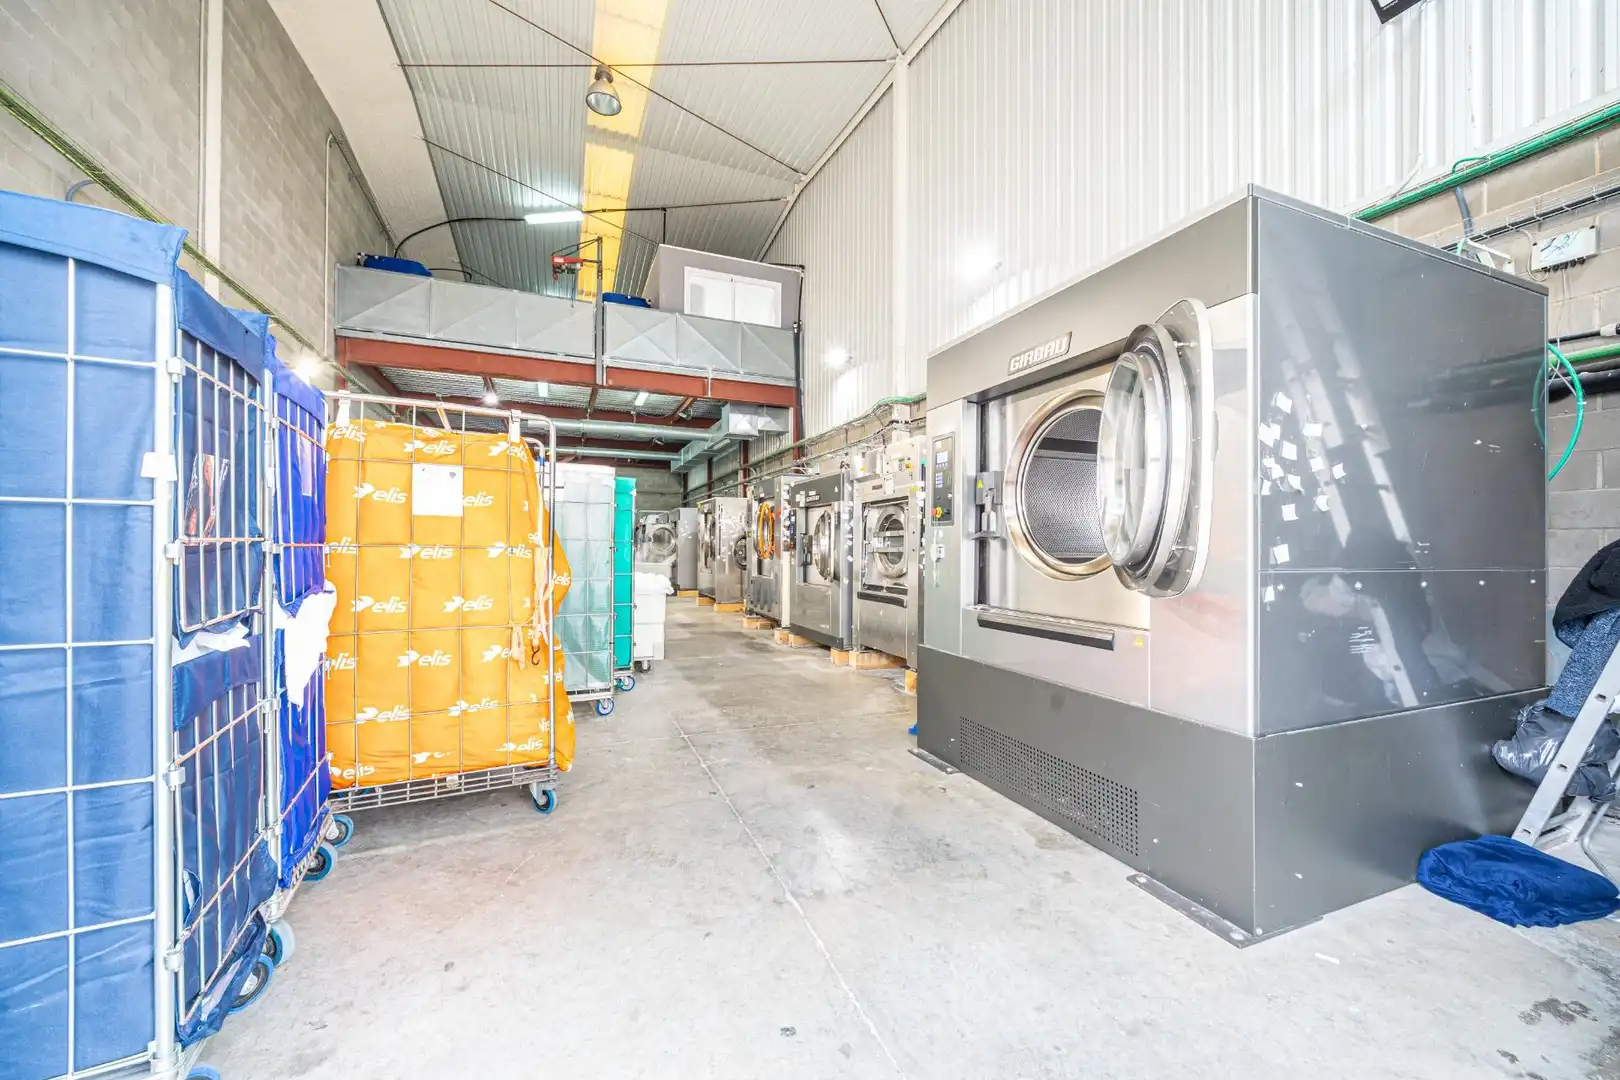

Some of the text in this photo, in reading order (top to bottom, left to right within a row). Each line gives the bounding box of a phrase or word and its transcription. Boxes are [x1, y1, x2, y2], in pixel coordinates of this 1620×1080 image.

[334, 425, 367, 442] elis
[423, 440, 456, 455] elis
[374, 487, 407, 504] elis
[464, 493, 494, 506] elis
[421, 544, 454, 559] elis
[507, 544, 532, 558] elis
[372, 597, 408, 613] elis
[462, 594, 493, 611] elis
[418, 650, 452, 666] elis
[376, 705, 410, 721] elis
[516, 738, 543, 751] elis
[344, 764, 376, 778] elis
